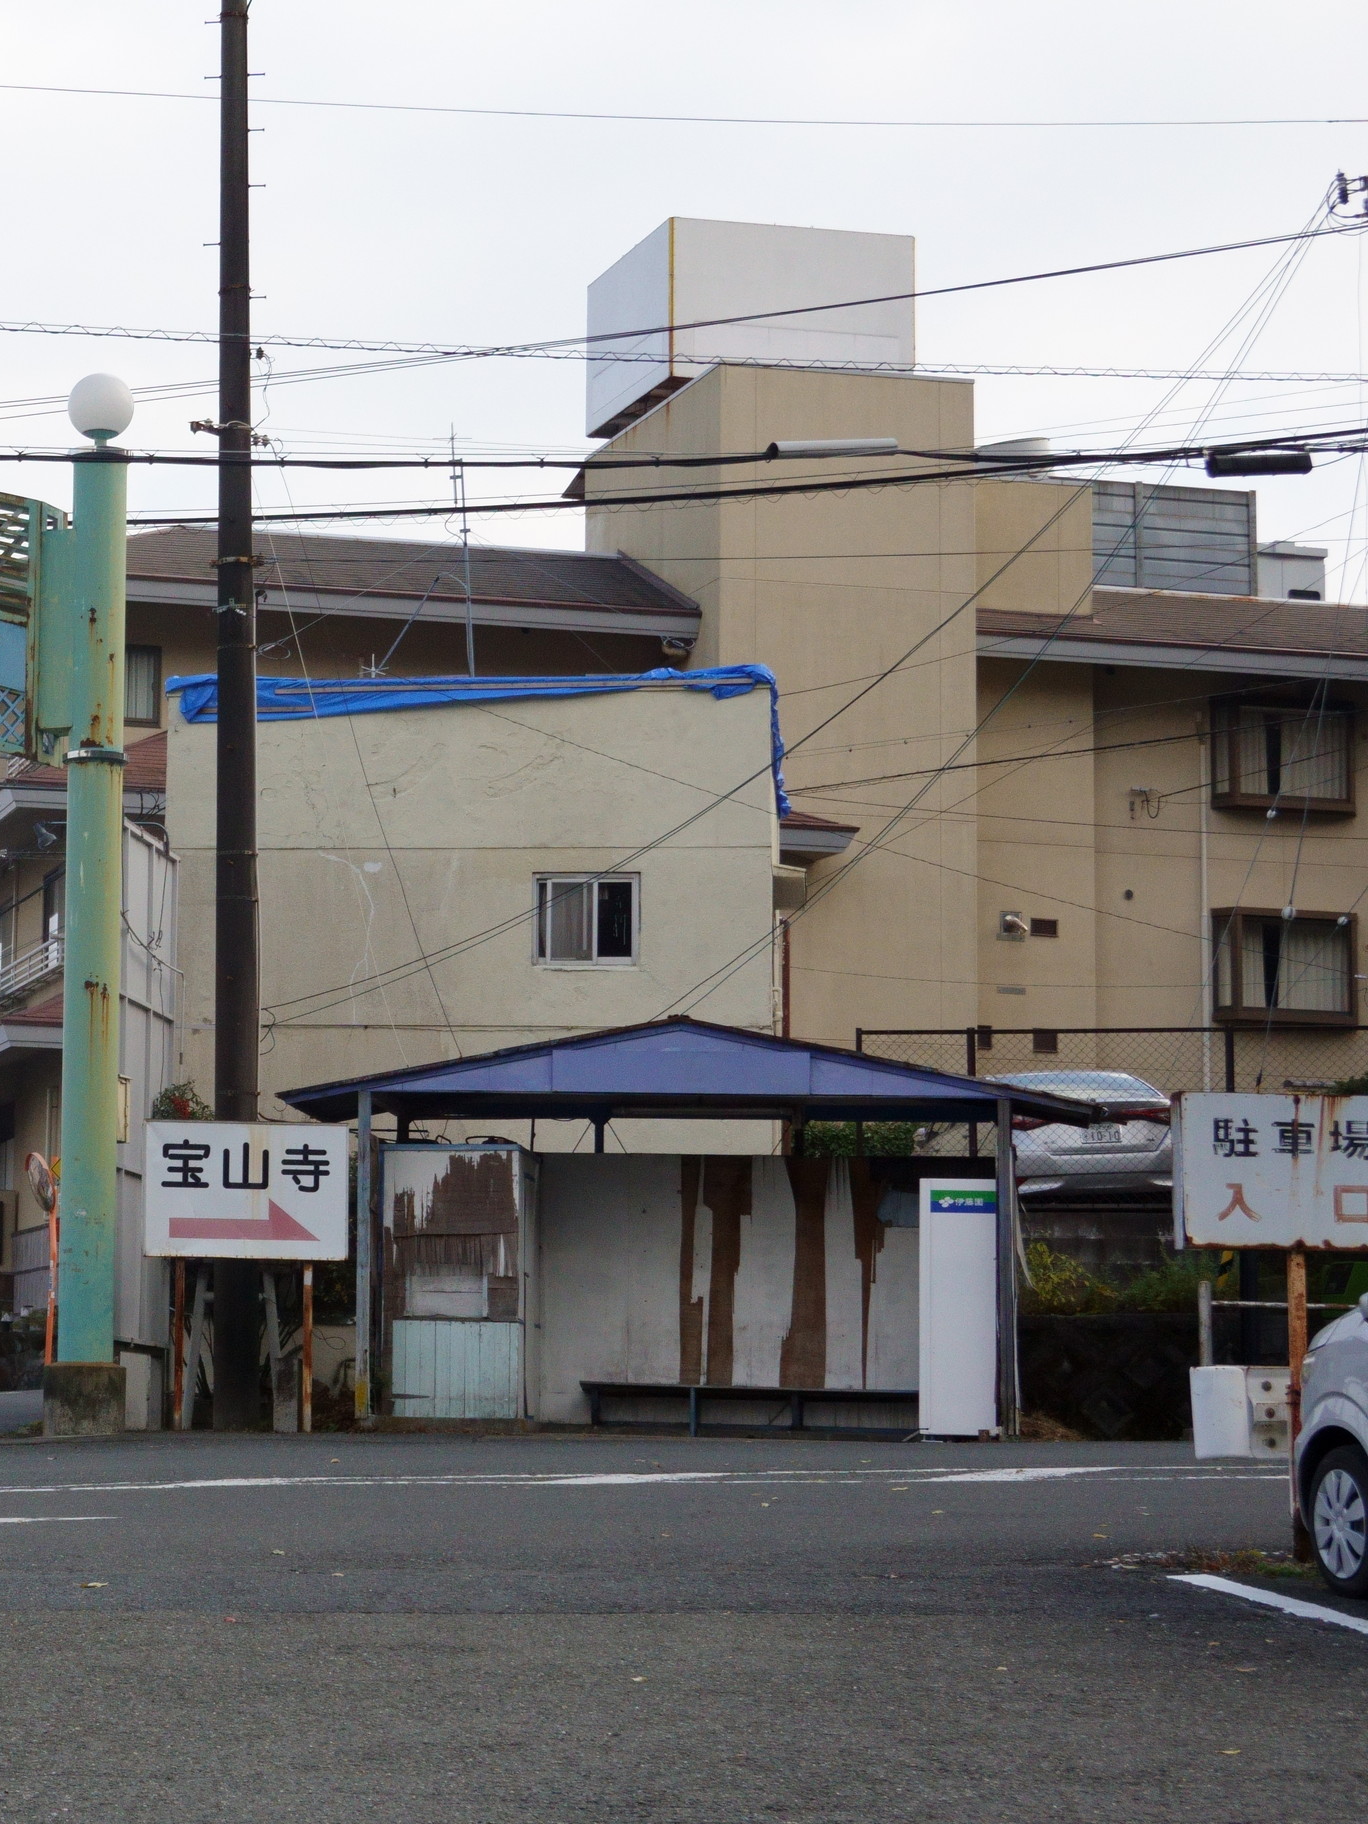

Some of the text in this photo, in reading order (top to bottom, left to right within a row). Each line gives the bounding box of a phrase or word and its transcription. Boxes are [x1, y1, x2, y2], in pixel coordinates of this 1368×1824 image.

[1212, 1117, 1368, 1160] 駐車場
[161, 1139, 331, 1193] 宝山寺
[1216, 1183, 1368, 1225] 入口
